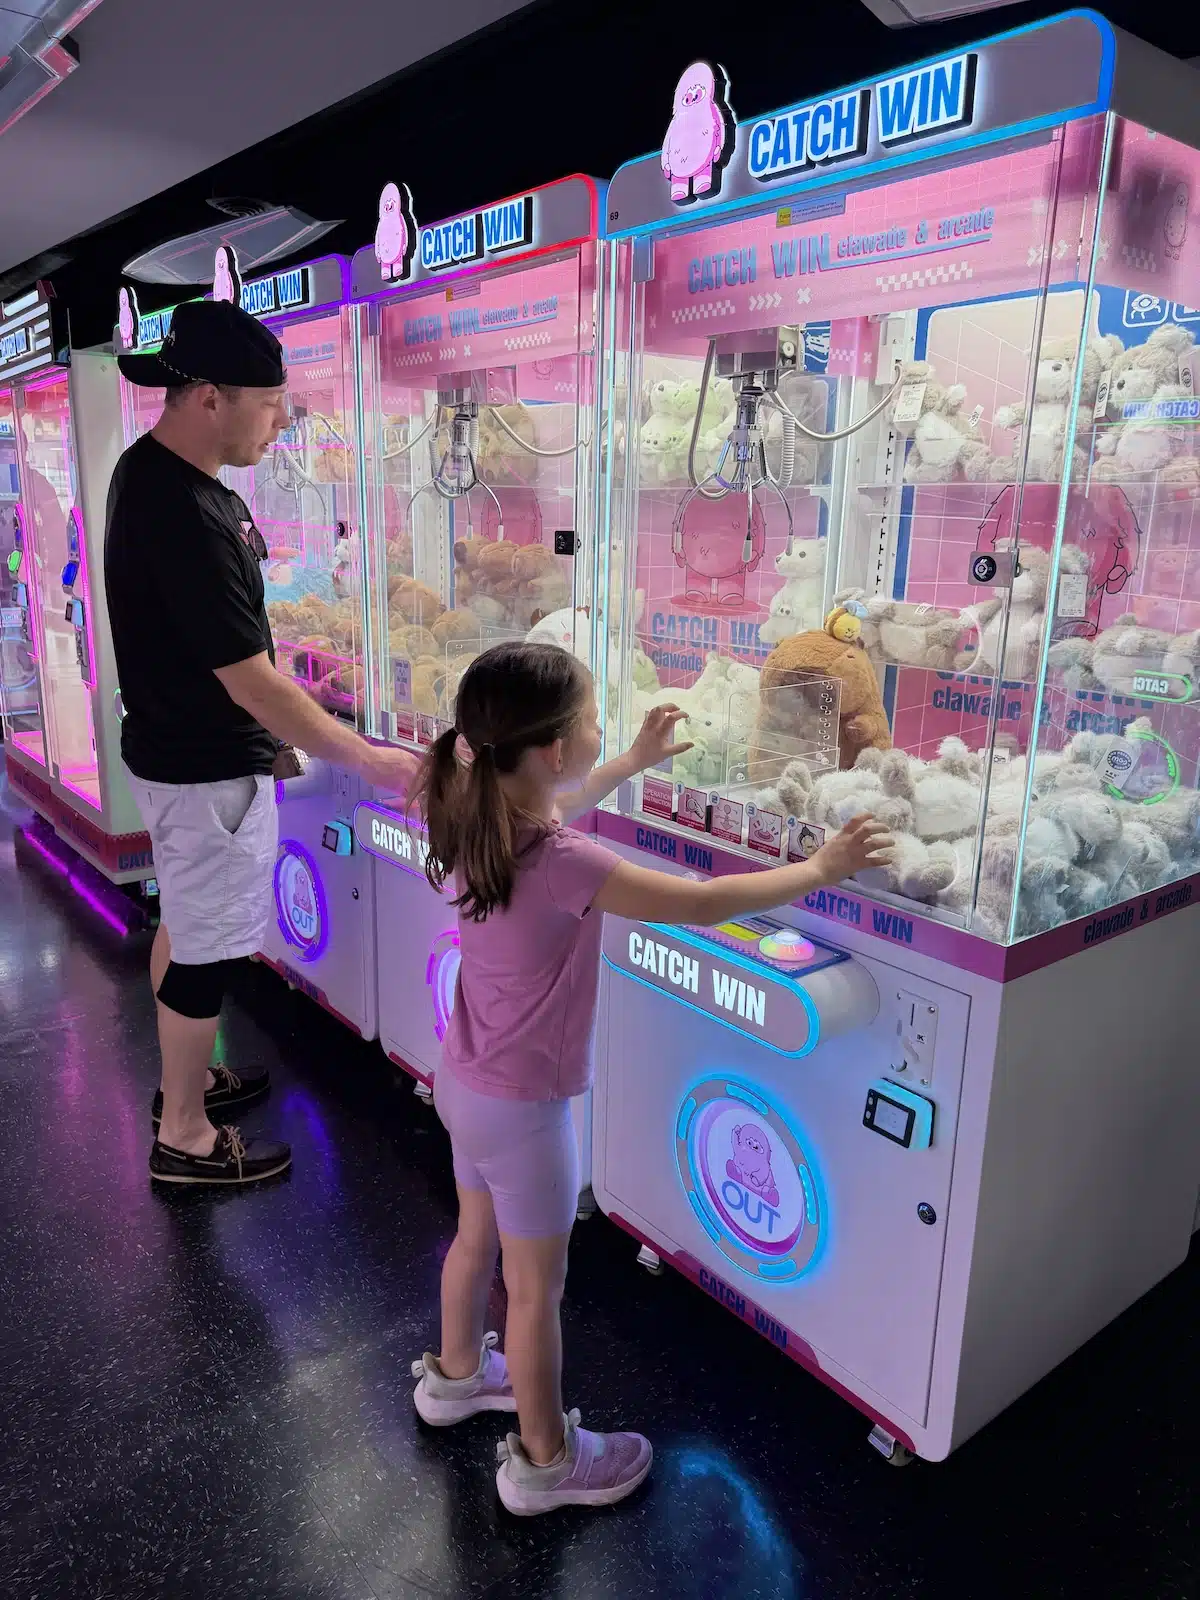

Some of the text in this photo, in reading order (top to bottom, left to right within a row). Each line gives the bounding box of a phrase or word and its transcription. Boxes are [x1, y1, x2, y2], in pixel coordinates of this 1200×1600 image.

[750, 60, 964, 174] CATCH WIN
[421, 201, 524, 266] CATCH WIN
[609, 211, 619, 221] 69
[688, 207, 995, 294] CATCH WIN clawade & arcade
[241, 271, 301, 313] CATCH WIN
[139, 316, 160, 342] CATCH
[404, 312, 443, 346] CATCH
[448, 306, 481, 339] WIN
[652, 612, 717, 650] CATCH
[652, 649, 702, 673] clawade
[677, 783, 682, 794] 1
[748, 805, 755, 815] 3
[371, 818, 411, 860] CATCH
[636, 827, 676, 858] CATCH
[684, 843, 712, 872] WIN
[291, 906, 314, 933] OUT
[804, 890, 913, 944] CATCH WIN
[1083, 883, 1192, 944] clawade & arcade
[629, 931, 766, 1027] CATCH WIN
[721, 1180, 781, 1235] OUT
[699, 1267, 787, 1349] CATCH WIN
